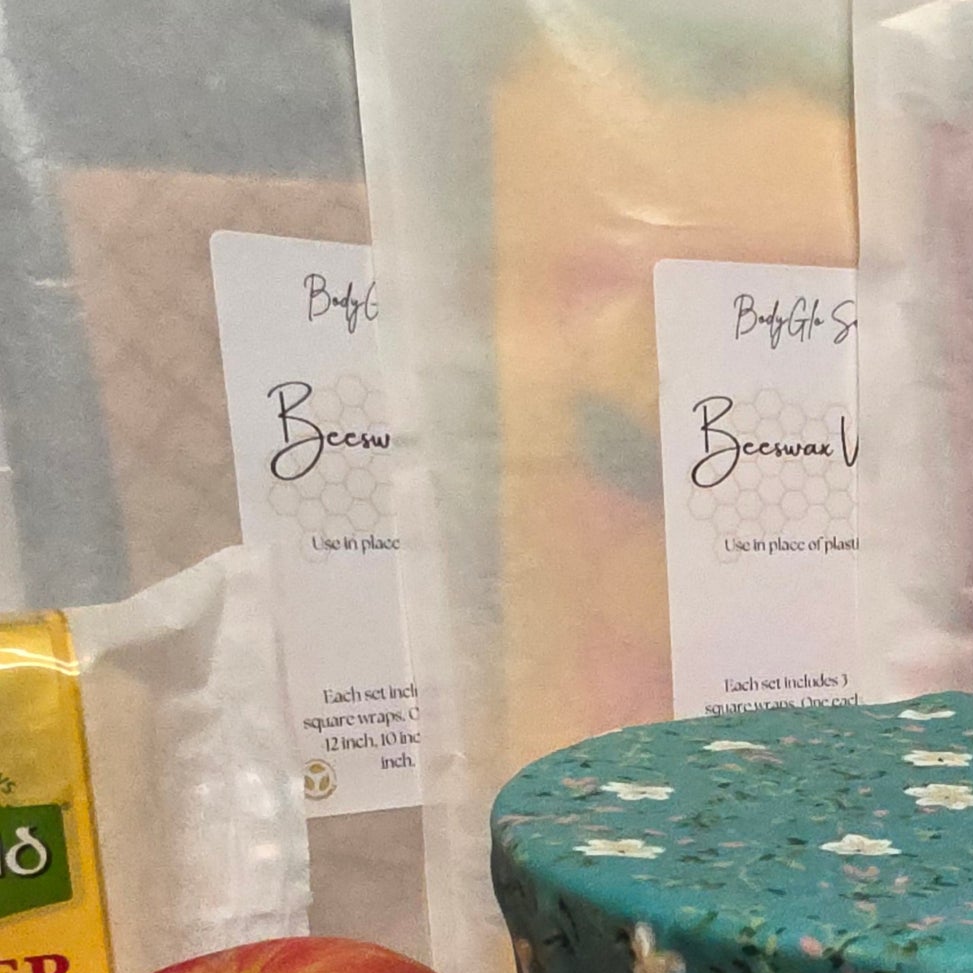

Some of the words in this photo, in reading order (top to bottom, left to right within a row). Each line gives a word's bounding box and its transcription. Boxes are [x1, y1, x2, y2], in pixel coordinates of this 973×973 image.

[691, 395, 834, 489] Beeswax
[311, 535, 341, 551] Use
[344, 535, 358, 550] in
[361, 534, 401, 555] place
[724, 538, 751, 552] Use
[752, 538, 766, 551] in
[769, 537, 806, 556] place
[808, 536, 824, 551] of
[724, 676, 760, 693] Each
[761, 677, 781, 691] set
[784, 672, 839, 690] includes
[842, 673, 849, 688] 3
[322, 685, 362, 705] Each
[364, 687, 387, 702] set
[303, 713, 355, 734] square
[325, 736, 340, 753] 12
[381, 731, 398, 747] 10
[381, 752, 416, 770] inch.
